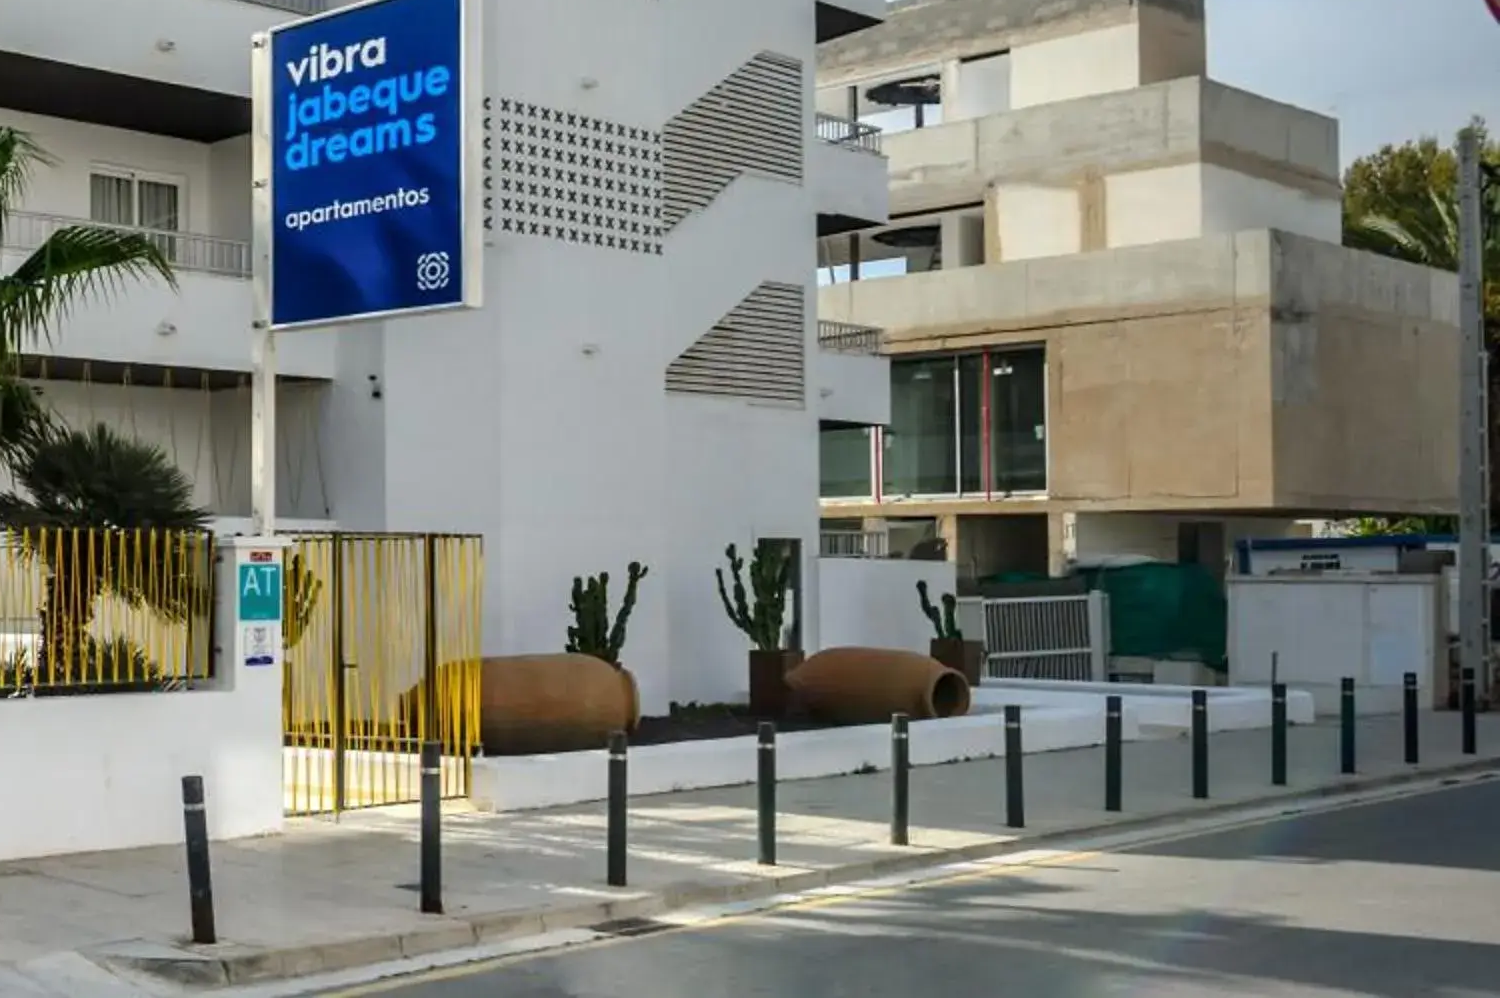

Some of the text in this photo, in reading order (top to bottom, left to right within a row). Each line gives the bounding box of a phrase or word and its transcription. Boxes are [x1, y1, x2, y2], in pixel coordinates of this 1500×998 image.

[286, 36, 387, 87] vibra
[286, 65, 450, 141] jabeque
[285, 112, 436, 171] dreams
[285, 186, 430, 231] apartamentos
[243, 567, 277, 597] AT
